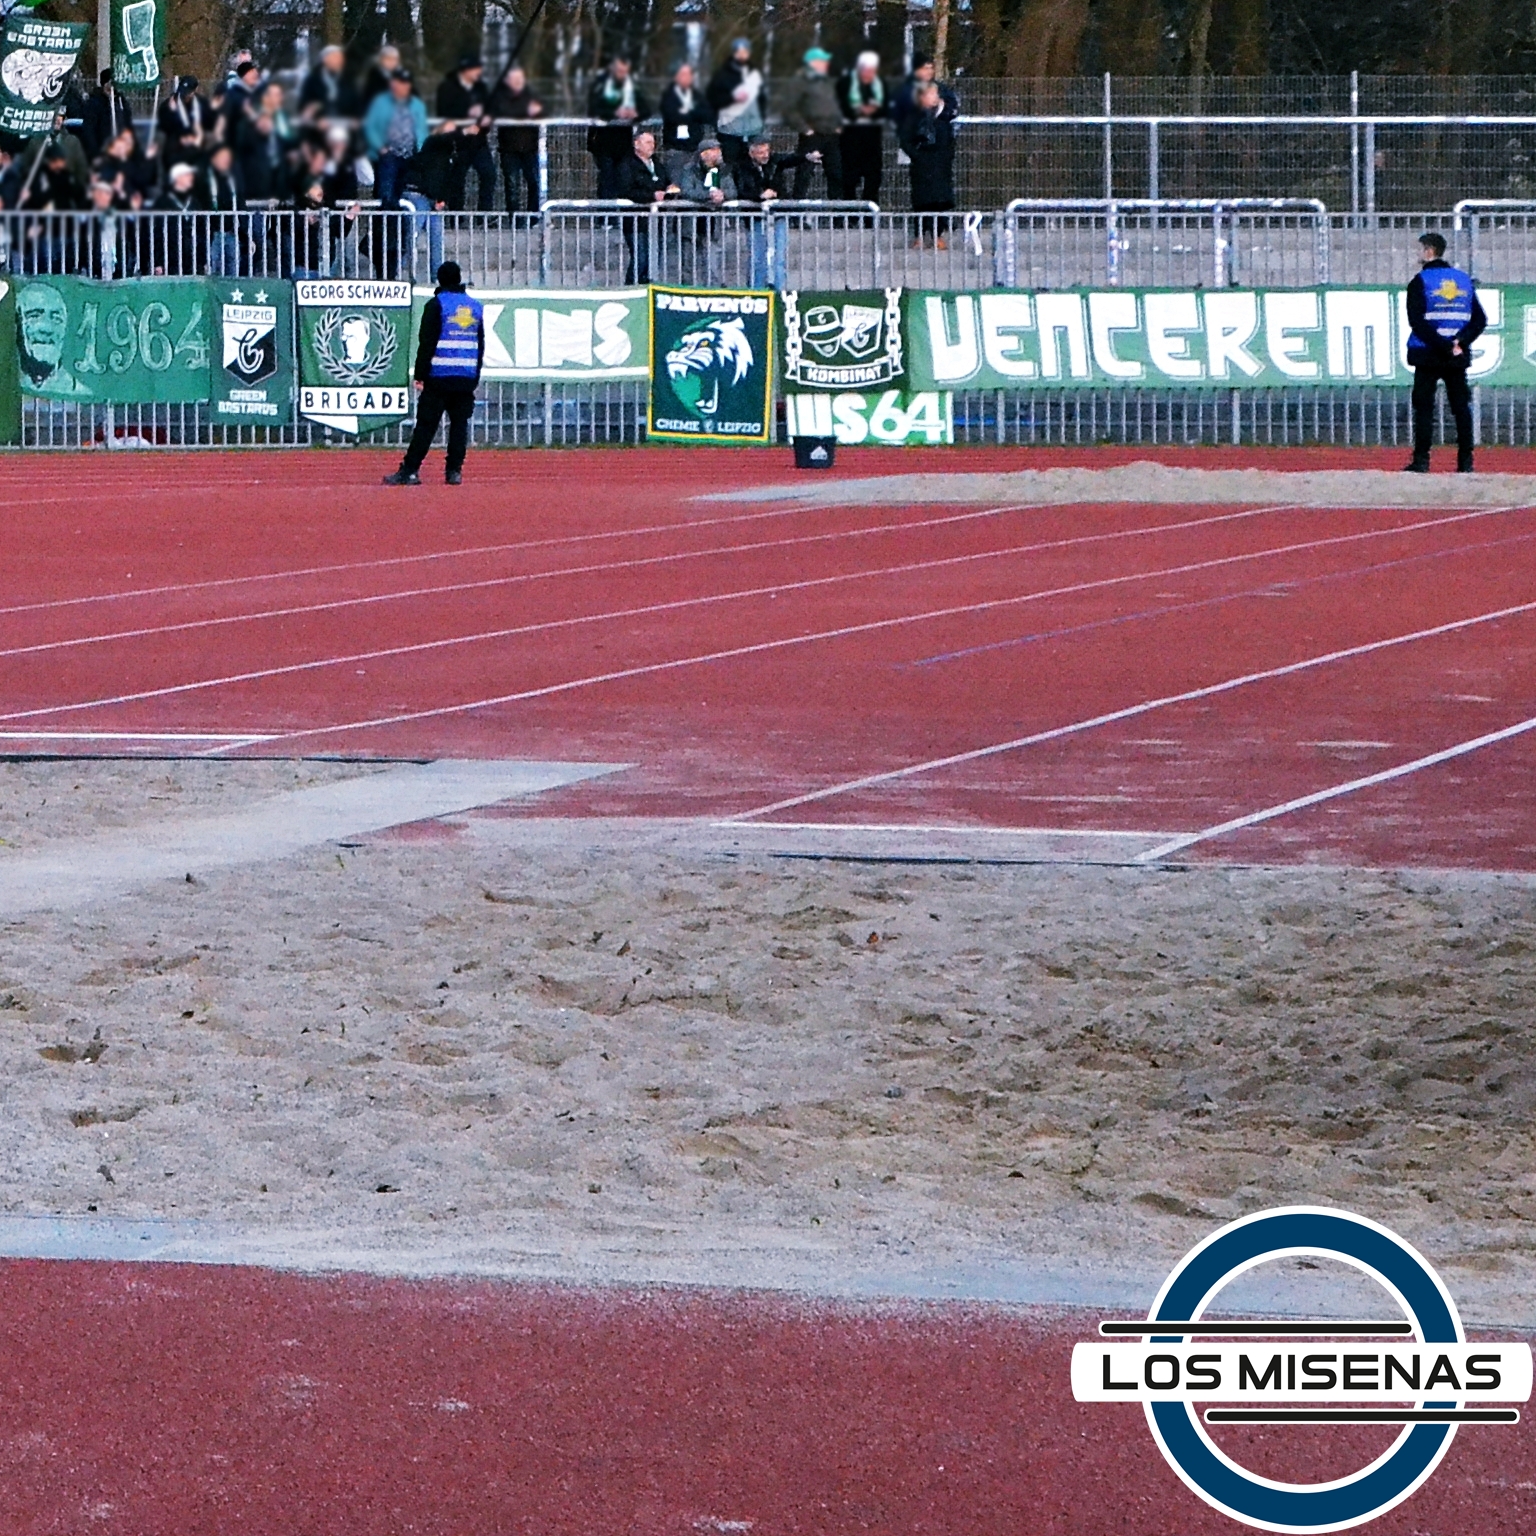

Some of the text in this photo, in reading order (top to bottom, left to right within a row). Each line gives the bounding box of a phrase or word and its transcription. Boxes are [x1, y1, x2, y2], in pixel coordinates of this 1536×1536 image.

[301, 284, 408, 300] GEORG SCHWARZ
[227, 307, 273, 321] LEIPZIG
[74, 300, 212, 374] 1964
[483, 302, 632, 368] KINS
[806, 366, 882, 383] KOMBINAT
[305, 391, 406, 410] BRIGADE
[656, 418, 761, 434] CHEMIE LEIPZIG
